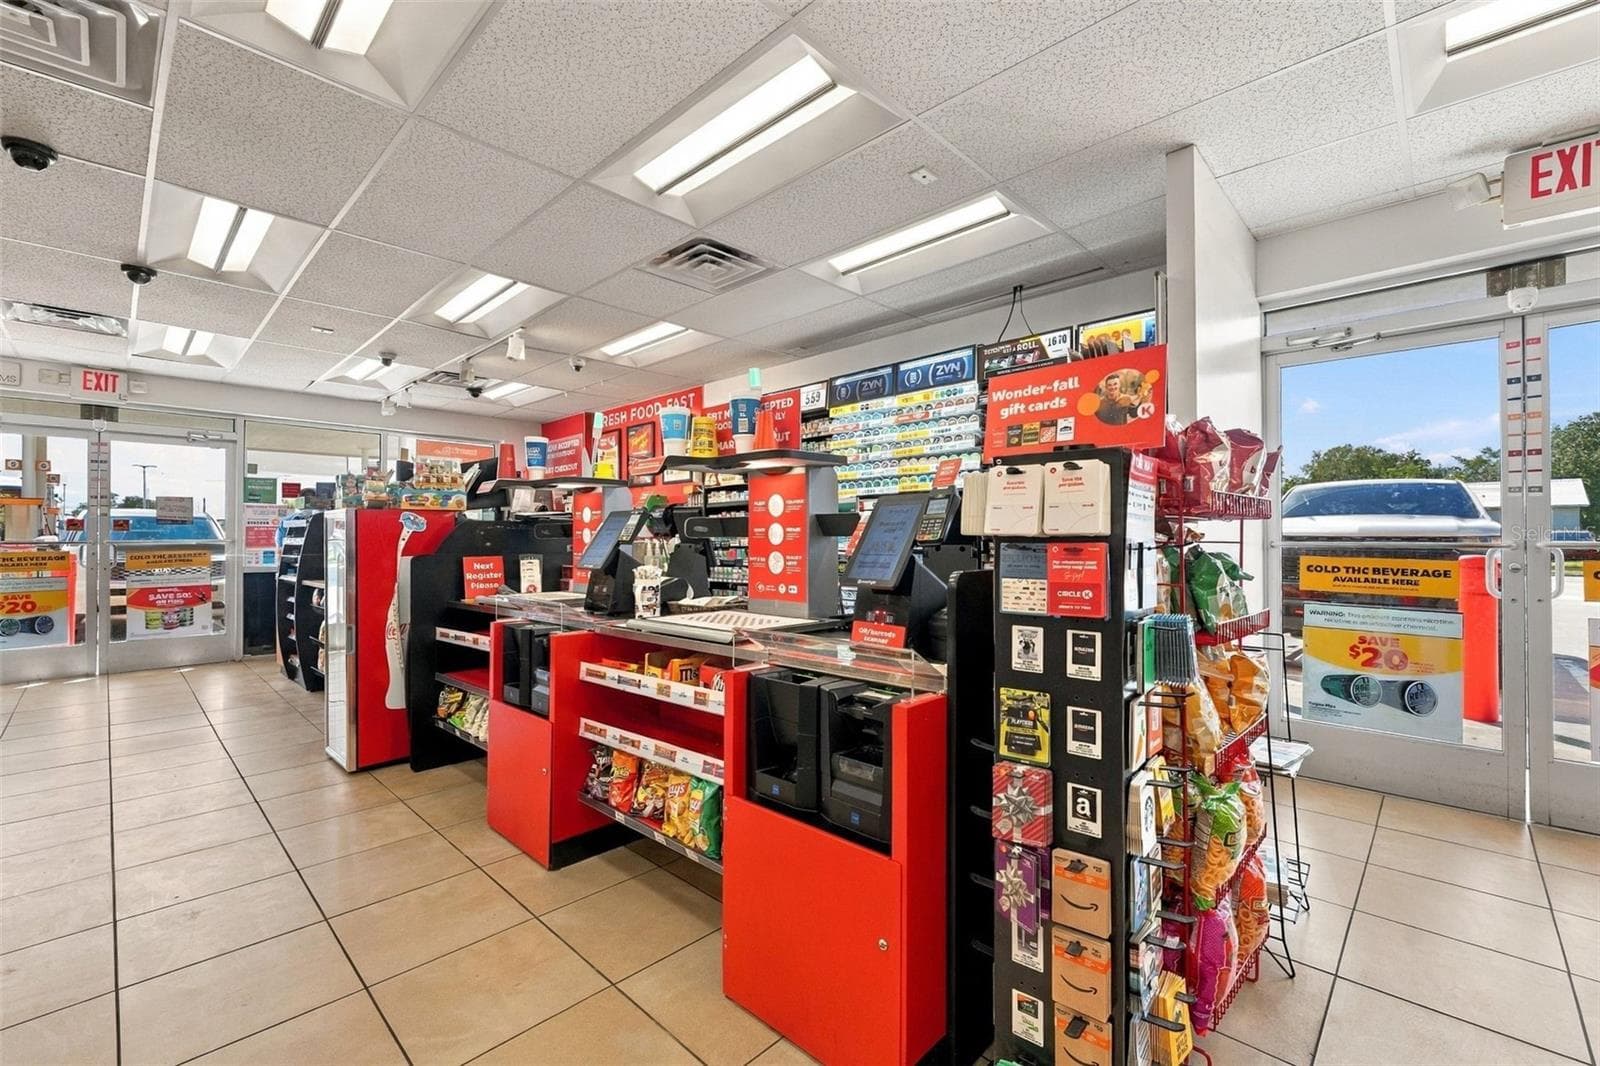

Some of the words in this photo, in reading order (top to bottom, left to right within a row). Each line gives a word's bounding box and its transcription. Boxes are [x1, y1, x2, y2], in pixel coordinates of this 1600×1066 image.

[1530, 139, 1600, 199] EXI
[936, 361, 960, 376] ZYN
[82, 370, 119, 393] EXIT
[862, 377, 882, 391] ZYN
[992, 376, 1080, 402] Wonder-fall
[602, 410, 627, 427] RESH
[630, 402, 661, 421] FOOD
[666, 391, 695, 409] FAST
[1000, 399, 1026, 420] gift
[1028, 396, 1068, 412] cards
[466, 572, 502, 581] Register
[1306, 564, 1341, 574] COLD
[1343, 566, 1370, 575] THC
[1372, 567, 1452, 579] BEVERAGE
[471, 582, 499, 590] Please
[1332, 576, 1390, 585] AVAILABLE
[1391, 578, 1421, 587] HERE
[148, 592, 175, 601] SAVE
[1056, 590, 1081, 598] CIRCLE
[1309, 609, 1346, 618] WARNING:
[1358, 635, 1400, 648] SAVE
[1348, 643, 1409, 671] $20
[1076, 795, 1091, 817] a
